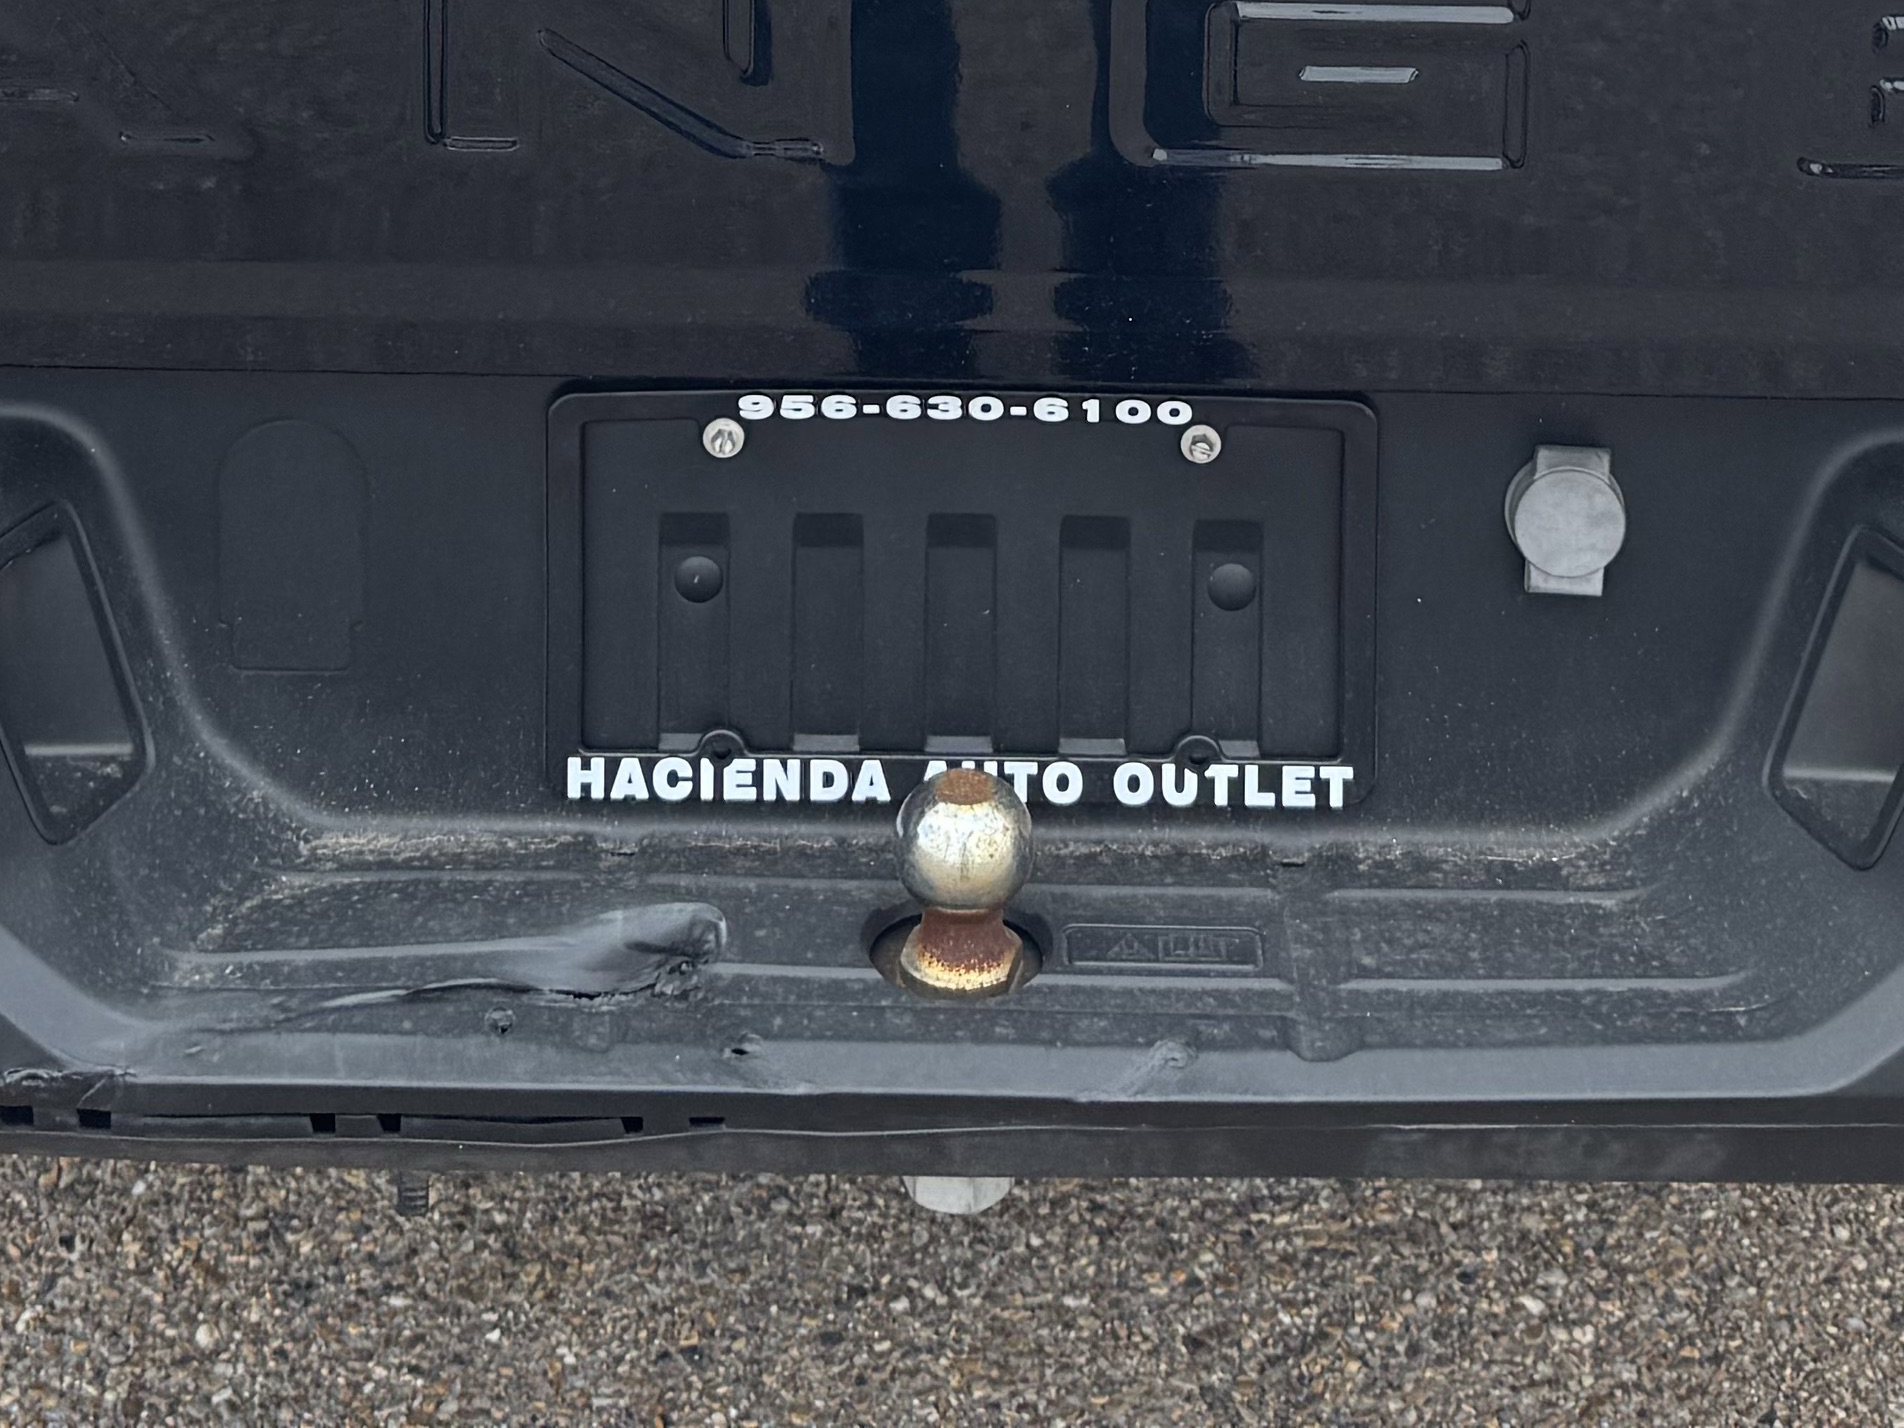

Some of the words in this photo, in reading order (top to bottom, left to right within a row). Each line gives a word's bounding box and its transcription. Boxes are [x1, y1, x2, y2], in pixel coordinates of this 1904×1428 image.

[738, 394, 1193, 425] 956-630-6100
[567, 757, 892, 801] HACIENDA
[1113, 762, 1354, 809] OUTLET
